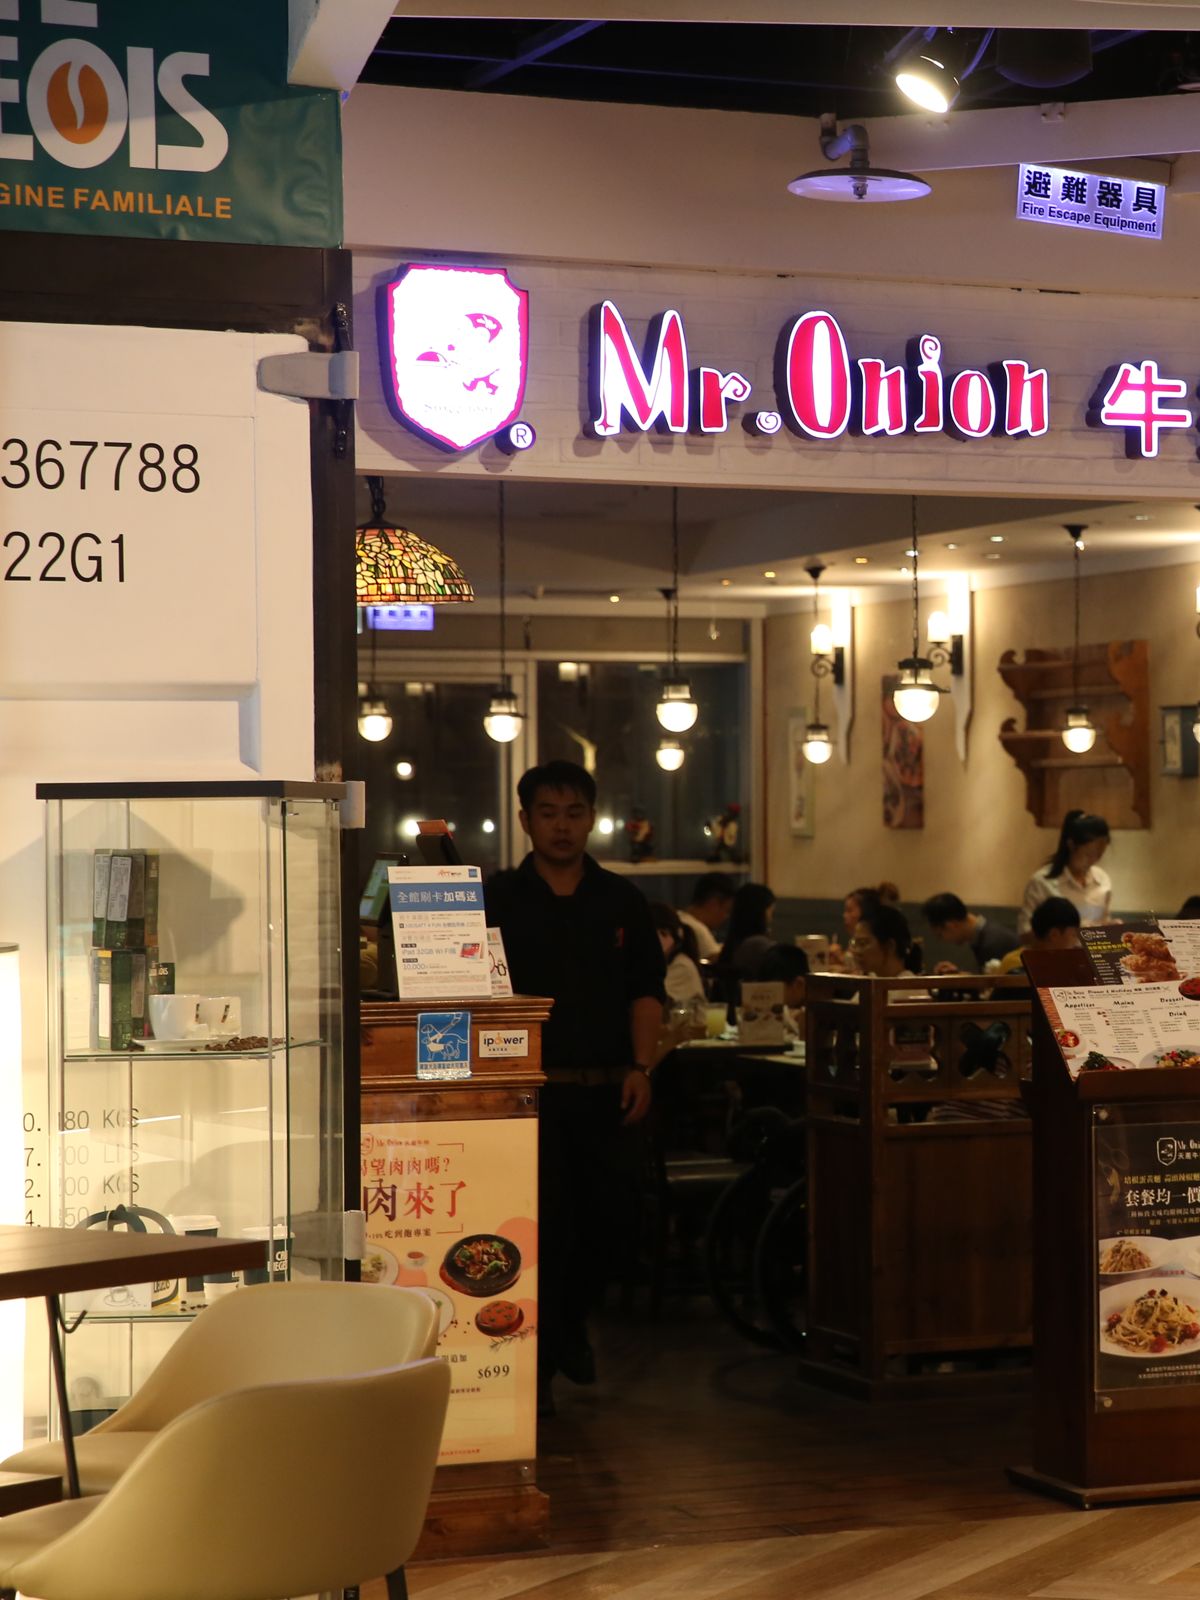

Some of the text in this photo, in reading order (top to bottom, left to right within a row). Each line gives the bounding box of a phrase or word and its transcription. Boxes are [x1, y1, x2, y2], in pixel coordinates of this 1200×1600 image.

[74, 188, 232, 219] FAMILIALE
[1024, 169, 1157, 215] 避難器具
[1022, 202, 1157, 233] Fire Escape Equipment
[0, 438, 200, 493] 367788
[3, 531, 126, 583] 22G1
[478, 1364, 511, 1380] $699
